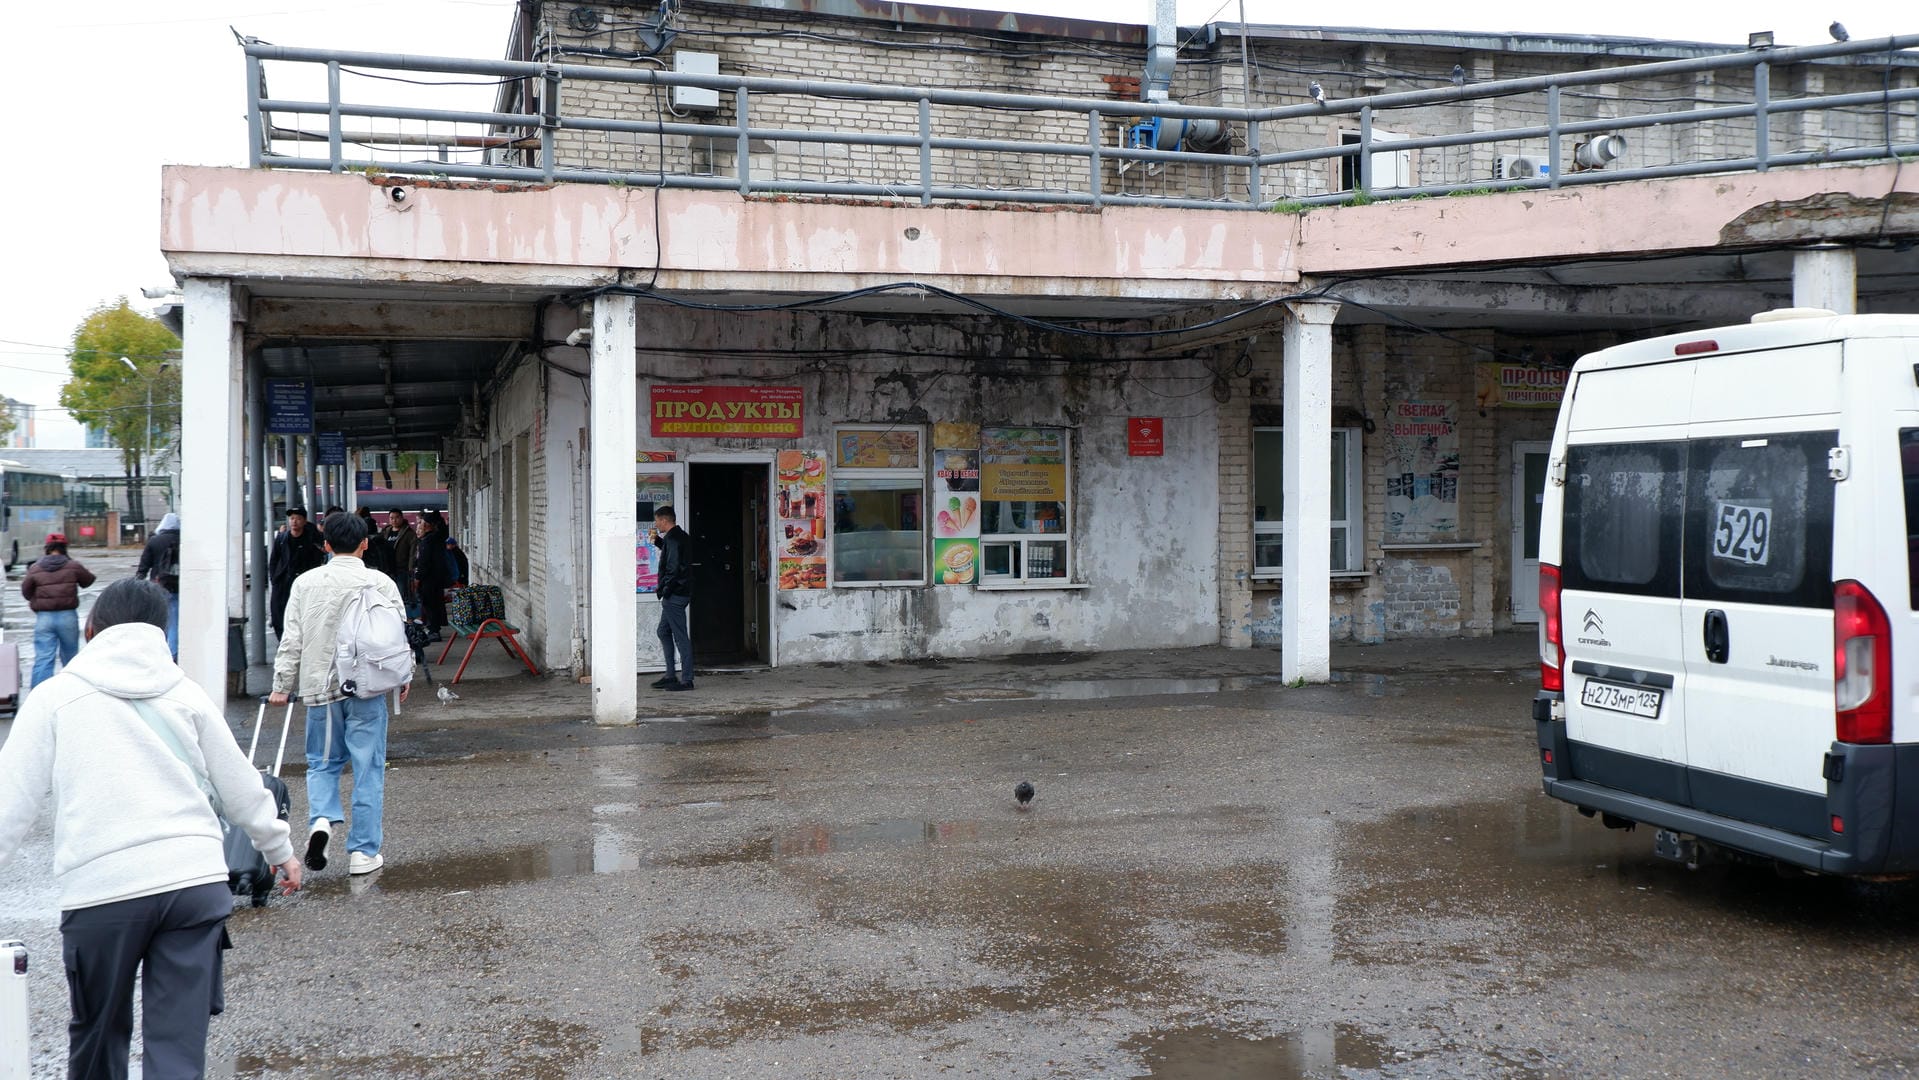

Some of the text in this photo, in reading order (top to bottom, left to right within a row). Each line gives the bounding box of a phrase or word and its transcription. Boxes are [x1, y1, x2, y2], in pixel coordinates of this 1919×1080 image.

[655, 401, 801, 420] ПРОДУКТЫ
[1398, 404, 1446, 417] СВЕЖАЯ
[661, 422, 797, 433] КРУГЛОСУТОЧНО
[1395, 423, 1449, 436] ВЫПЕЧКА
[1716, 505, 1768, 562] 529
[1638, 692, 1657, 708] 125
